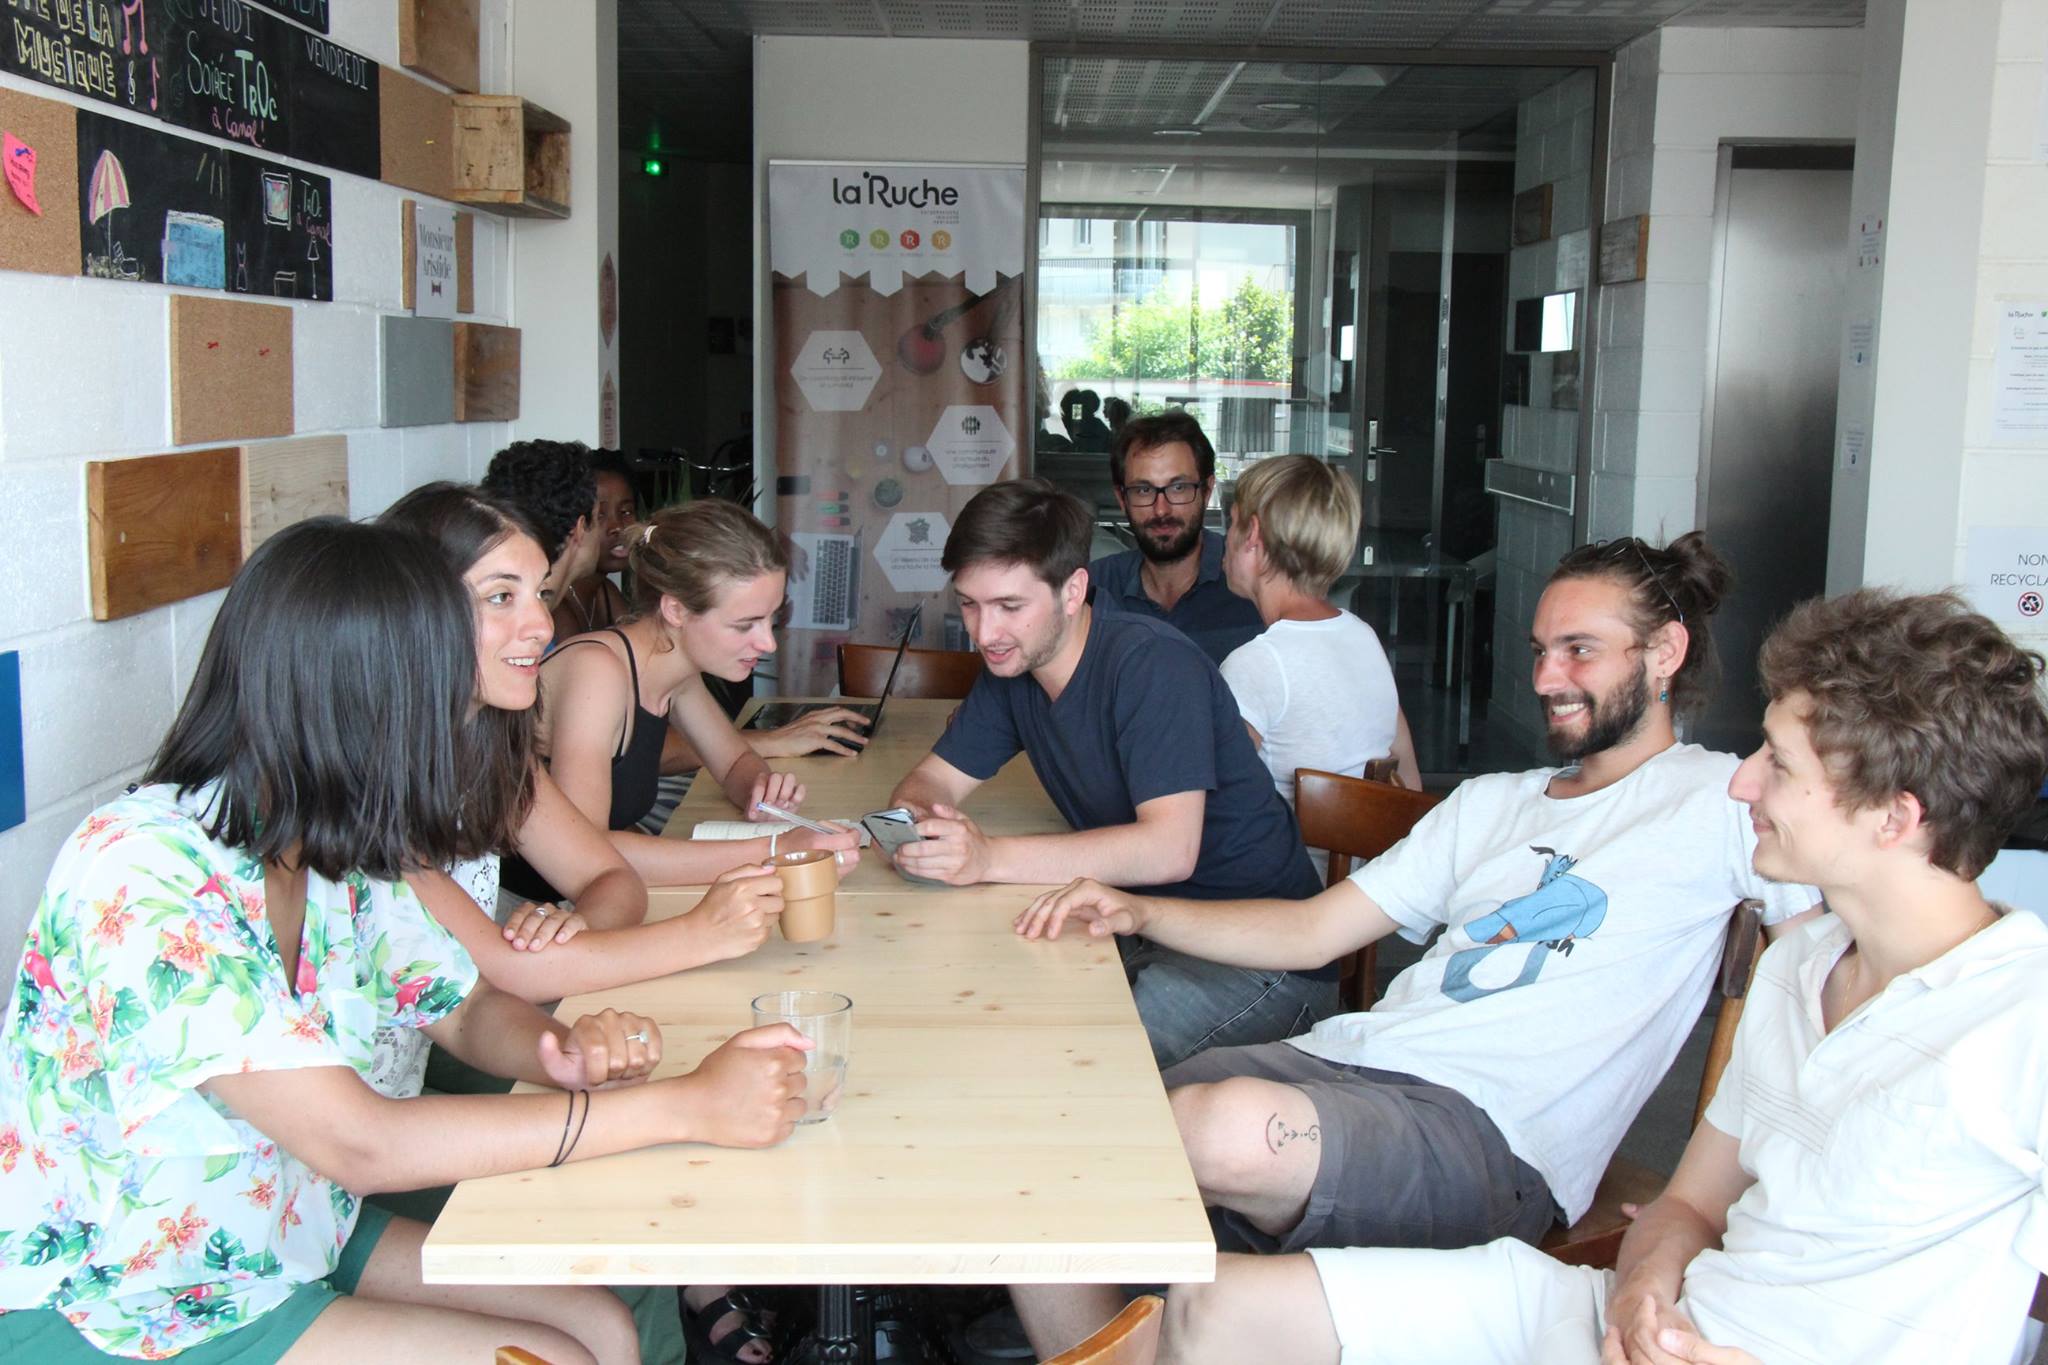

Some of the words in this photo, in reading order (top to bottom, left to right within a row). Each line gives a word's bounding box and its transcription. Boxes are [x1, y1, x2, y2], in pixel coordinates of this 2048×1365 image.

[305, 34, 369, 92] VENDREDI
[832, 177, 862, 205] la
[862, 170, 959, 209] Ruche
